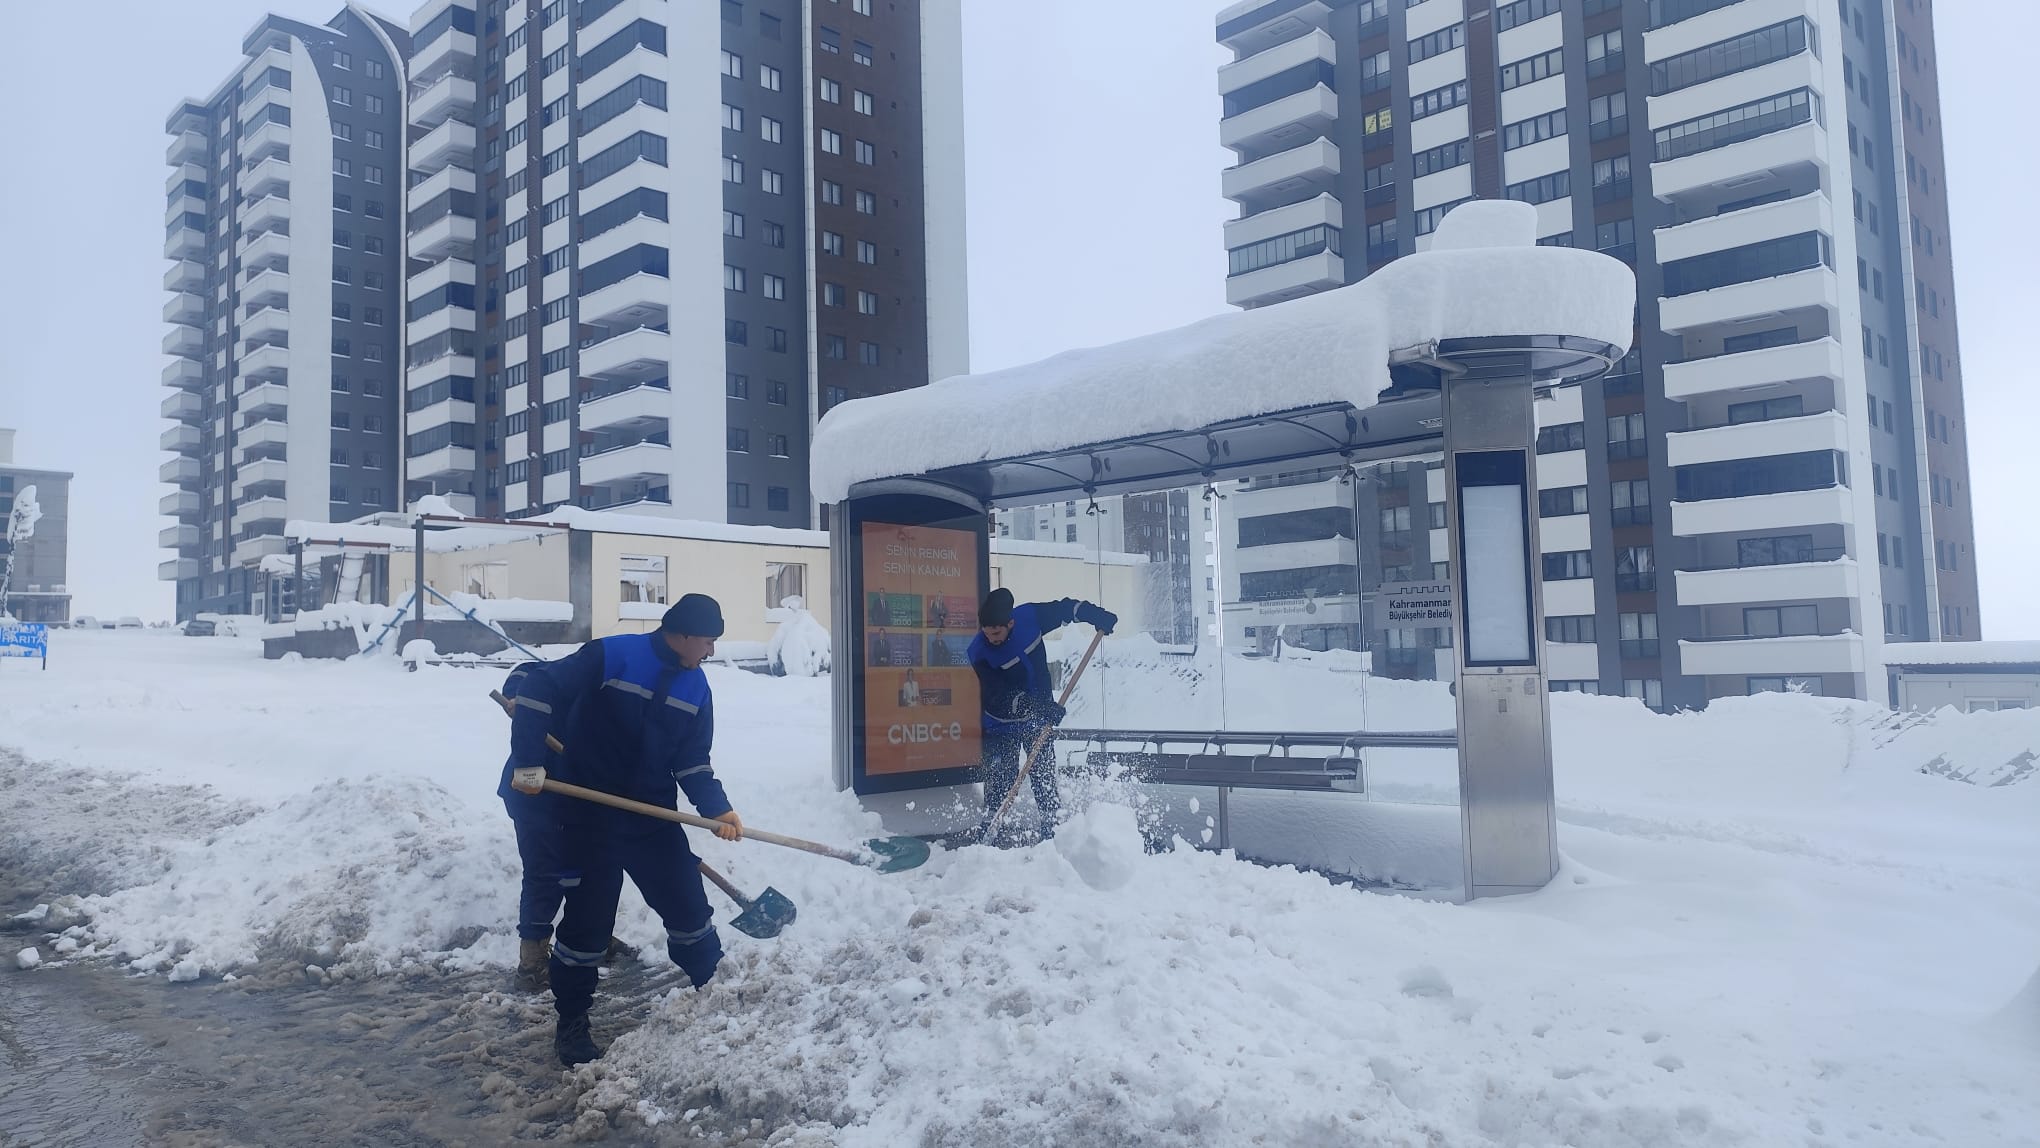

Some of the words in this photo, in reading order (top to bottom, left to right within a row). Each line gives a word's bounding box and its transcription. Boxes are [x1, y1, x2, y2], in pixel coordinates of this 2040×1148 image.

[918, 564, 960, 577] KANALIN
[1389, 599, 1452, 608] Kahramanmar
[1389, 609, 1427, 621] Büyükşehir
[1427, 608, 1453, 620] Belediy
[887, 721, 962, 745] CNBC-e
